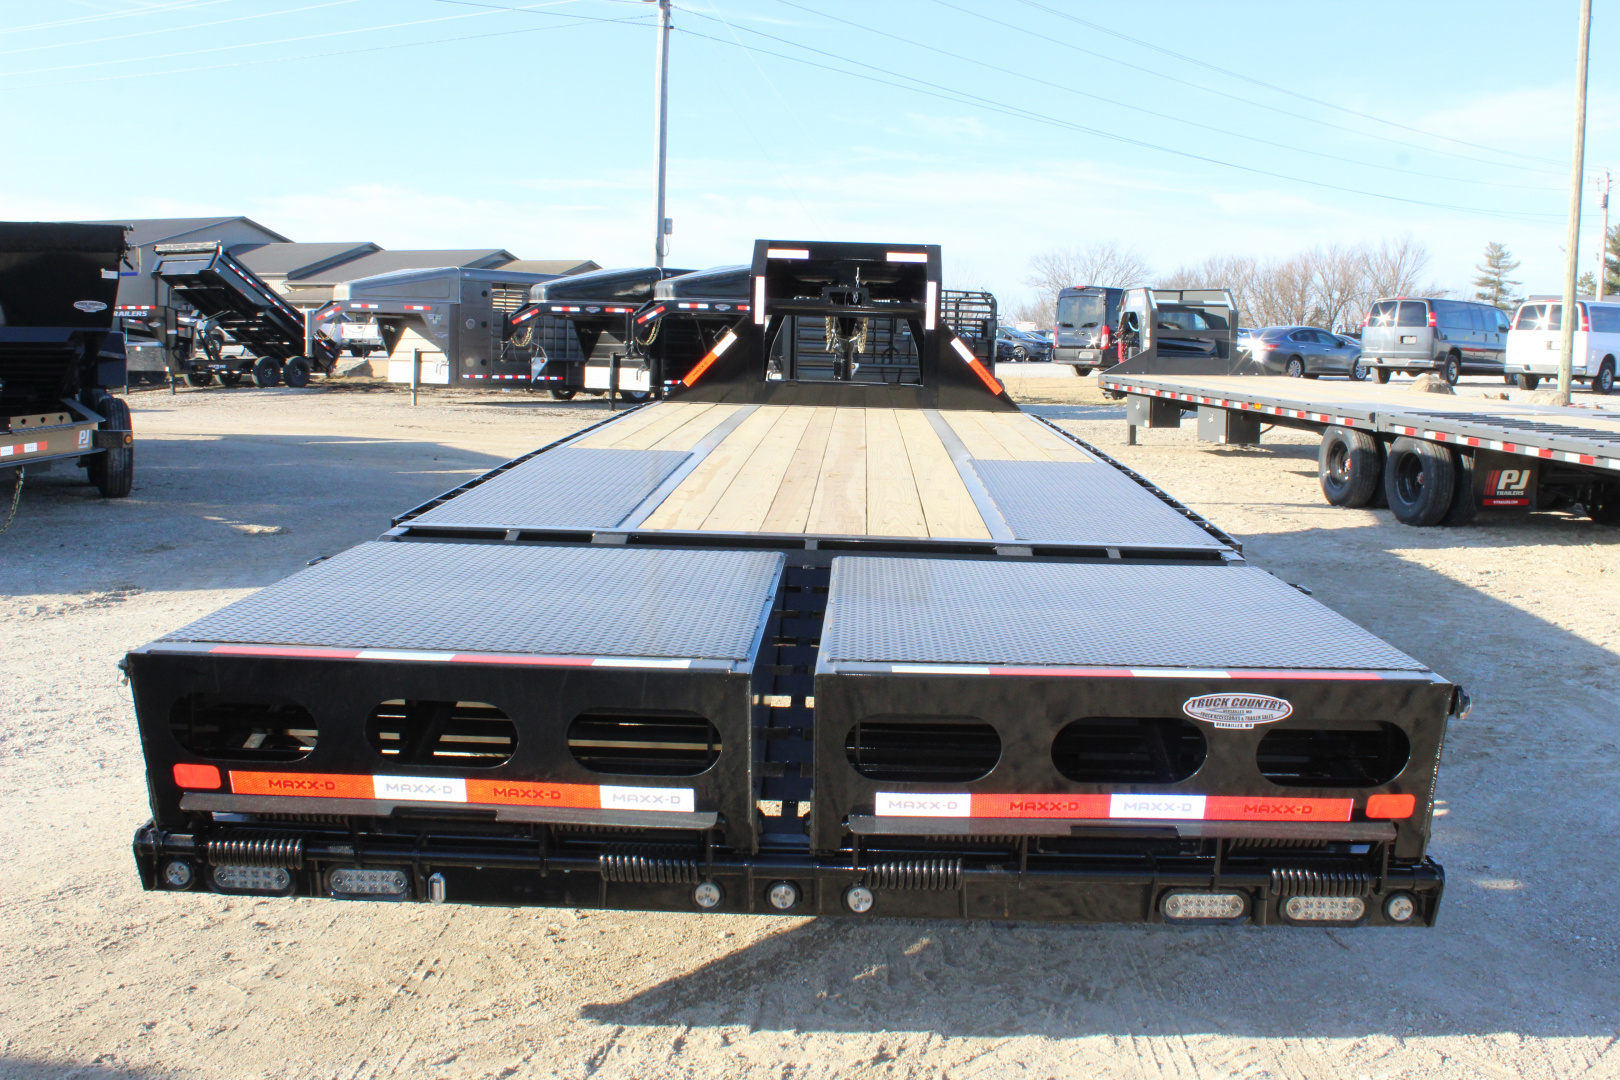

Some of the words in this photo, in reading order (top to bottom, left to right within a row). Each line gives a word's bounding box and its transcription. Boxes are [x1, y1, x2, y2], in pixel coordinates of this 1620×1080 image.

[79, 429, 91, 444] PJ
[1497, 469, 1531, 490] PJ
[1191, 698, 1230, 708] TRUCK
[1231, 698, 1286, 710] COUNTRY
[268, 779, 336, 791] MAXX-D
[386, 782, 453, 795] MAXX-D
[493, 787, 562, 800] MAXX-D
[612, 793, 681, 805] MAXX-D
[888, 800, 958, 810] MAXX-D
[1009, 801, 1080, 811] MAXX-D
[1123, 801, 1193, 812] MAXX-D
[1243, 803, 1313, 815] MAXX-D
